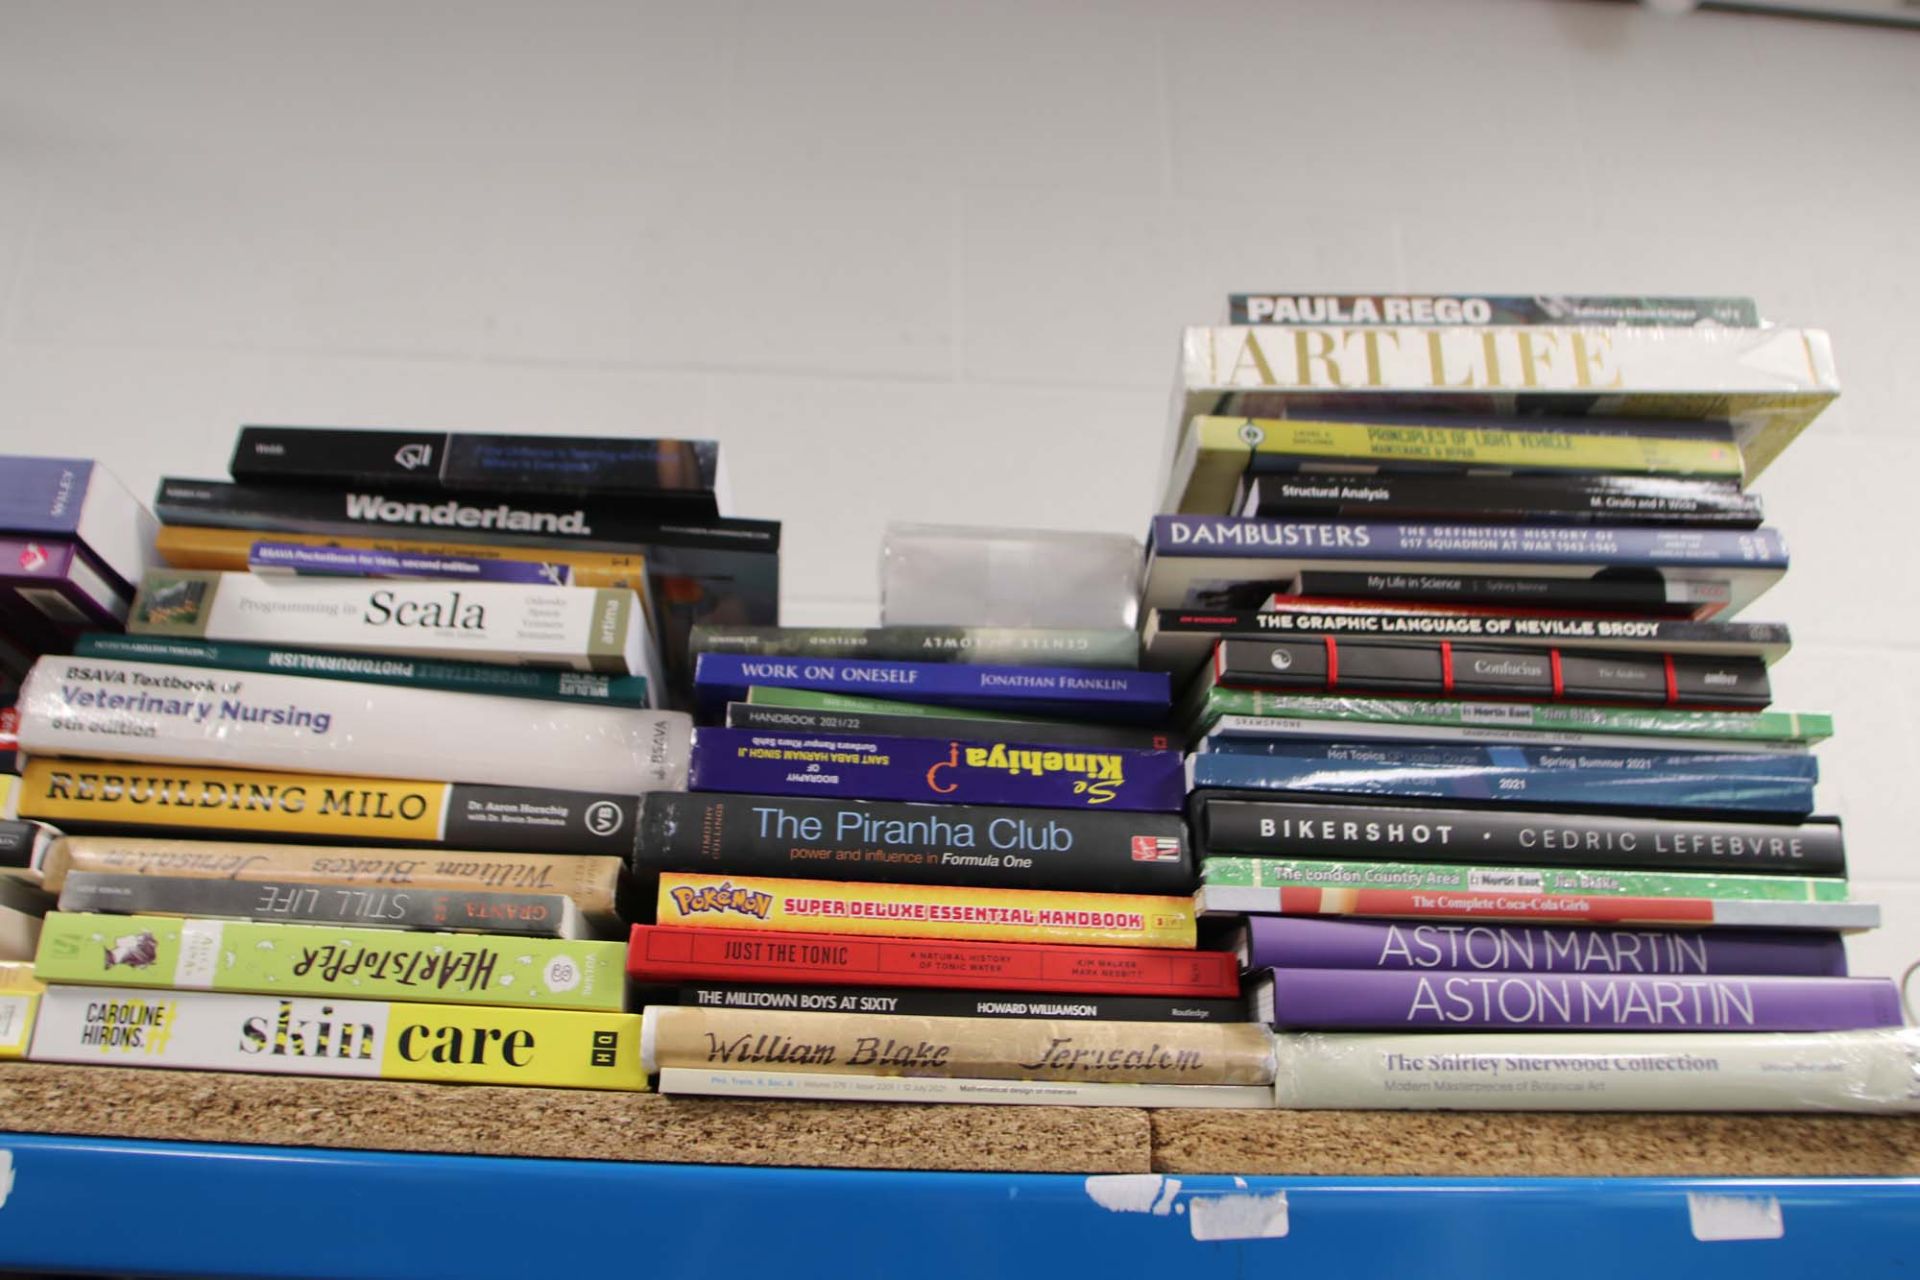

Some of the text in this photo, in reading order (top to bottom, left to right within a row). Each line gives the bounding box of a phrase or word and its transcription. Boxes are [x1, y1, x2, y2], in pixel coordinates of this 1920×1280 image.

[1246, 297, 1491, 324] PAULA REGO
[1222, 327, 1624, 389] ART LIFE
[51, 470, 74, 517] WILEY
[1282, 484, 1390, 501] Structural Analysis
[346, 493, 591, 535] Wonderland.
[1171, 522, 1370, 547] DAMBUSTERS
[1399, 527, 1427, 537] THE
[1433, 528, 1517, 539] DEFINITIVE
[1524, 530, 1587, 541] HISTORY
[1401, 538, 1423, 549] 617
[1426, 538, 1498, 551] SQUADRON
[1501, 539, 1518, 550] AT
[1521, 540, 1552, 551] WAR
[258, 547, 294, 562] BSAVA
[359, 553, 374, 566] for
[402, 557, 441, 571] second
[442, 559, 480, 573] edition
[1367, 575, 1462, 590] My Life in Science
[239, 589, 487, 631] Programming in Scala
[599, 598, 620, 646] artima
[1256, 615, 1660, 637] THE GRAPHIC LANGUAGE OF NEVILLE BRODY
[269, 652, 414, 677] PHOTOJOURNALISM
[742, 662, 1127, 690] WORK ON ONESELF JONATHAN FRANKLIN
[1475, 659, 1542, 676] Confucius
[65, 666, 215, 693] BSAVA Textbook
[61, 685, 332, 734] Veterinary Nursing
[750, 711, 861, 729] HANDBOOK 2021/22
[737, 747, 890, 766] SANT BABA HARNAM SINGH JI
[806, 763, 820, 773] OF
[965, 743, 1124, 781] Kinehiya
[1327, 750, 1652, 770] Hot Topics Spring Summer 2021
[786, 772, 839, 784] BIOGRAPHY
[1498, 778, 1526, 790] 2021
[46, 772, 426, 821] REBUILDING MILO
[1073, 779, 1126, 805] Se
[467, 800, 517, 813] Dr. Aaron
[752, 806, 1074, 853] The Piranha Club
[1260, 818, 1804, 858] BIKERSHOT CEDRIC LEFEBVRE
[790, 846, 1032, 869] power and influence in Formula One
[436, 859, 553, 888] William
[1274, 866, 1303, 881] The
[1305, 868, 1361, 883] London
[1364, 870, 1424, 886] Country
[1427, 871, 1459, 885] Area
[1517, 876, 1540, 887] East
[255, 885, 320, 913] LIFE
[337, 889, 411, 920] STILL
[464, 901, 549, 922] GRANTA
[1412, 895, 1435, 908] The
[1437, 896, 1494, 910] Complete
[784, 897, 846, 917] SUPER
[850, 901, 924, 920] DELUXE
[929, 904, 1034, 925] ESSENTIAL
[1038, 909, 1144, 931] HANDBOOK
[724, 941, 849, 966] JUST THE TONIC
[919, 952, 966, 962] NATURAL
[968, 953, 1012, 963] HISTORY
[1378, 924, 1709, 974] ASTON MARTIN
[293, 946, 499, 990] HEARTSTOPPER
[919, 961, 1003, 973] OF TONIC WATER
[1071, 968, 1098, 977] MARK
[1076, 959, 1138, 969] KIM WALKER
[697, 989, 723, 1005] THE
[725, 991, 798, 1008] MILLTOWN
[800, 993, 837, 1010] BOYS
[839, 995, 858, 1010] AT
[859, 996, 899, 1012] SIXTY
[976, 1001, 1028, 1016] HOWARD
[1028, 1003, 1097, 1018] WILLIAMSON
[1407, 977, 1755, 1026] ASTON MARTIN
[86, 1002, 166, 1027] CAROLINE
[81, 1025, 146, 1049] HIRONS.
[238, 1000, 535, 1068] skin care
[704, 1032, 1204, 1072] William Blake Jerusalem
[1384, 1053, 1720, 1077] The Shirley Sherwood Collection
[959, 1084, 1008, 1095] Mathematical
[1009, 1086, 1033, 1097] design
[1384, 1080, 1431, 1092] Modern
[1516, 1081, 1528, 1092] of
[1587, 1082, 1605, 1092] Art
